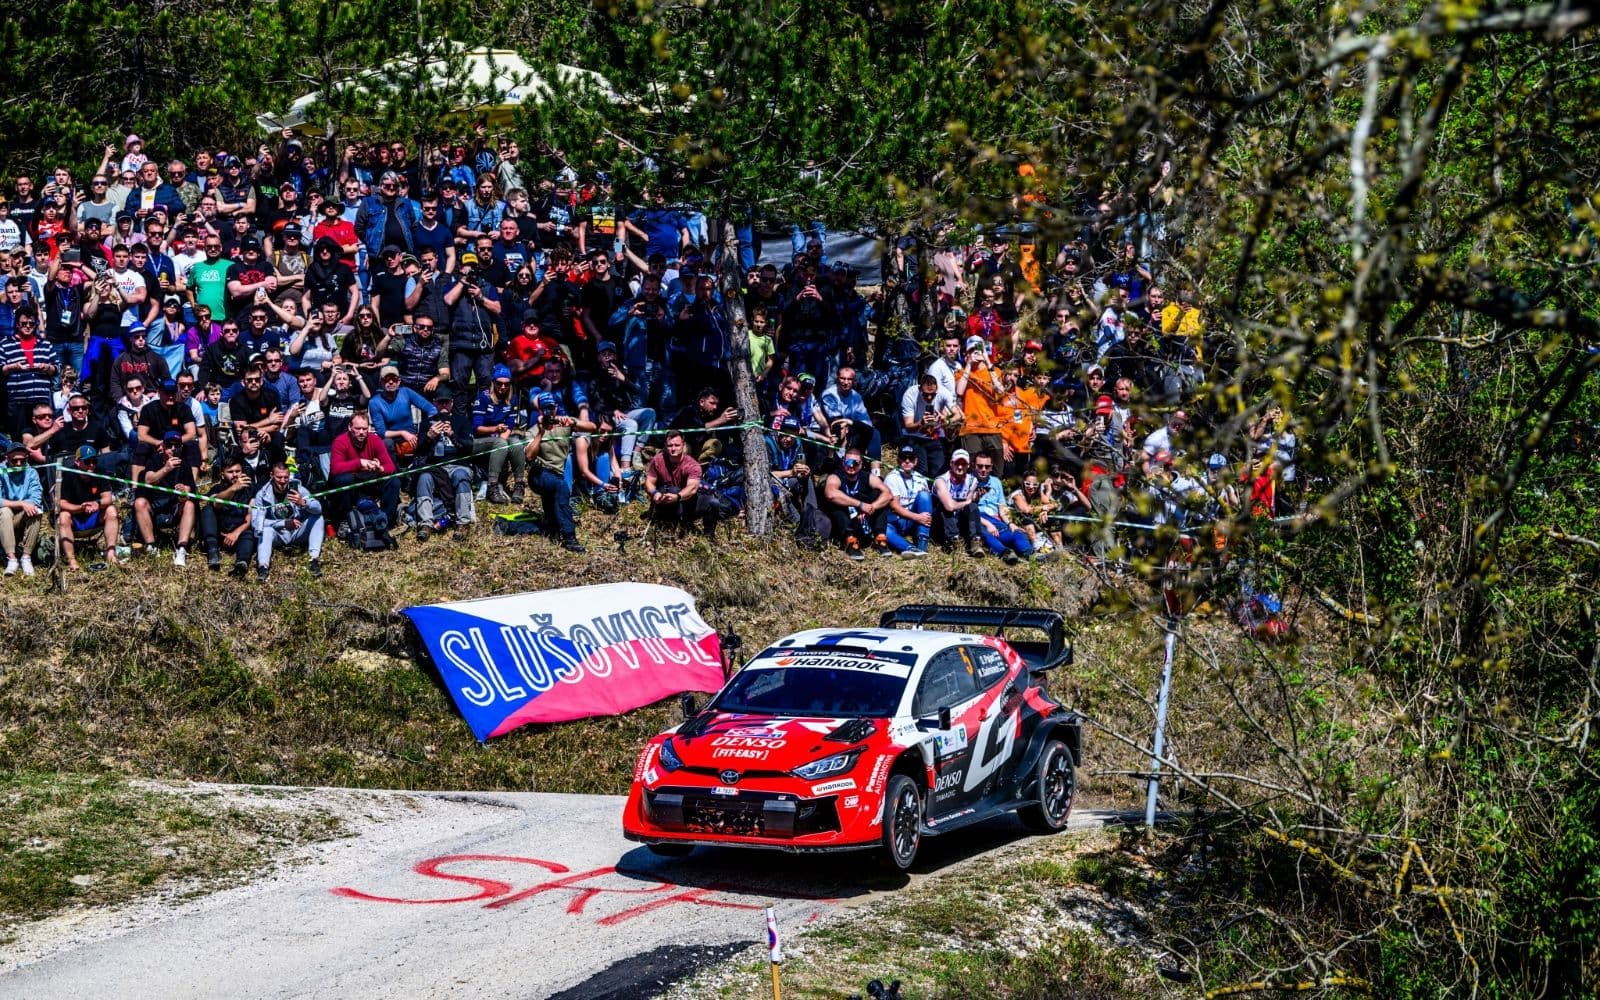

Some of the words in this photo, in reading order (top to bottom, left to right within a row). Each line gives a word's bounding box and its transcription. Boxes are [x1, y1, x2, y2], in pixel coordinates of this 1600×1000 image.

[440, 604, 722, 707] SLUŠOVICE
[958, 646, 974, 676] 5
[710, 737, 787, 749] DENSO
[865, 753, 887, 793] Panasonic
[874, 754, 895, 795] AUTOMOTIVE
[934, 769, 962, 792] DENSO
